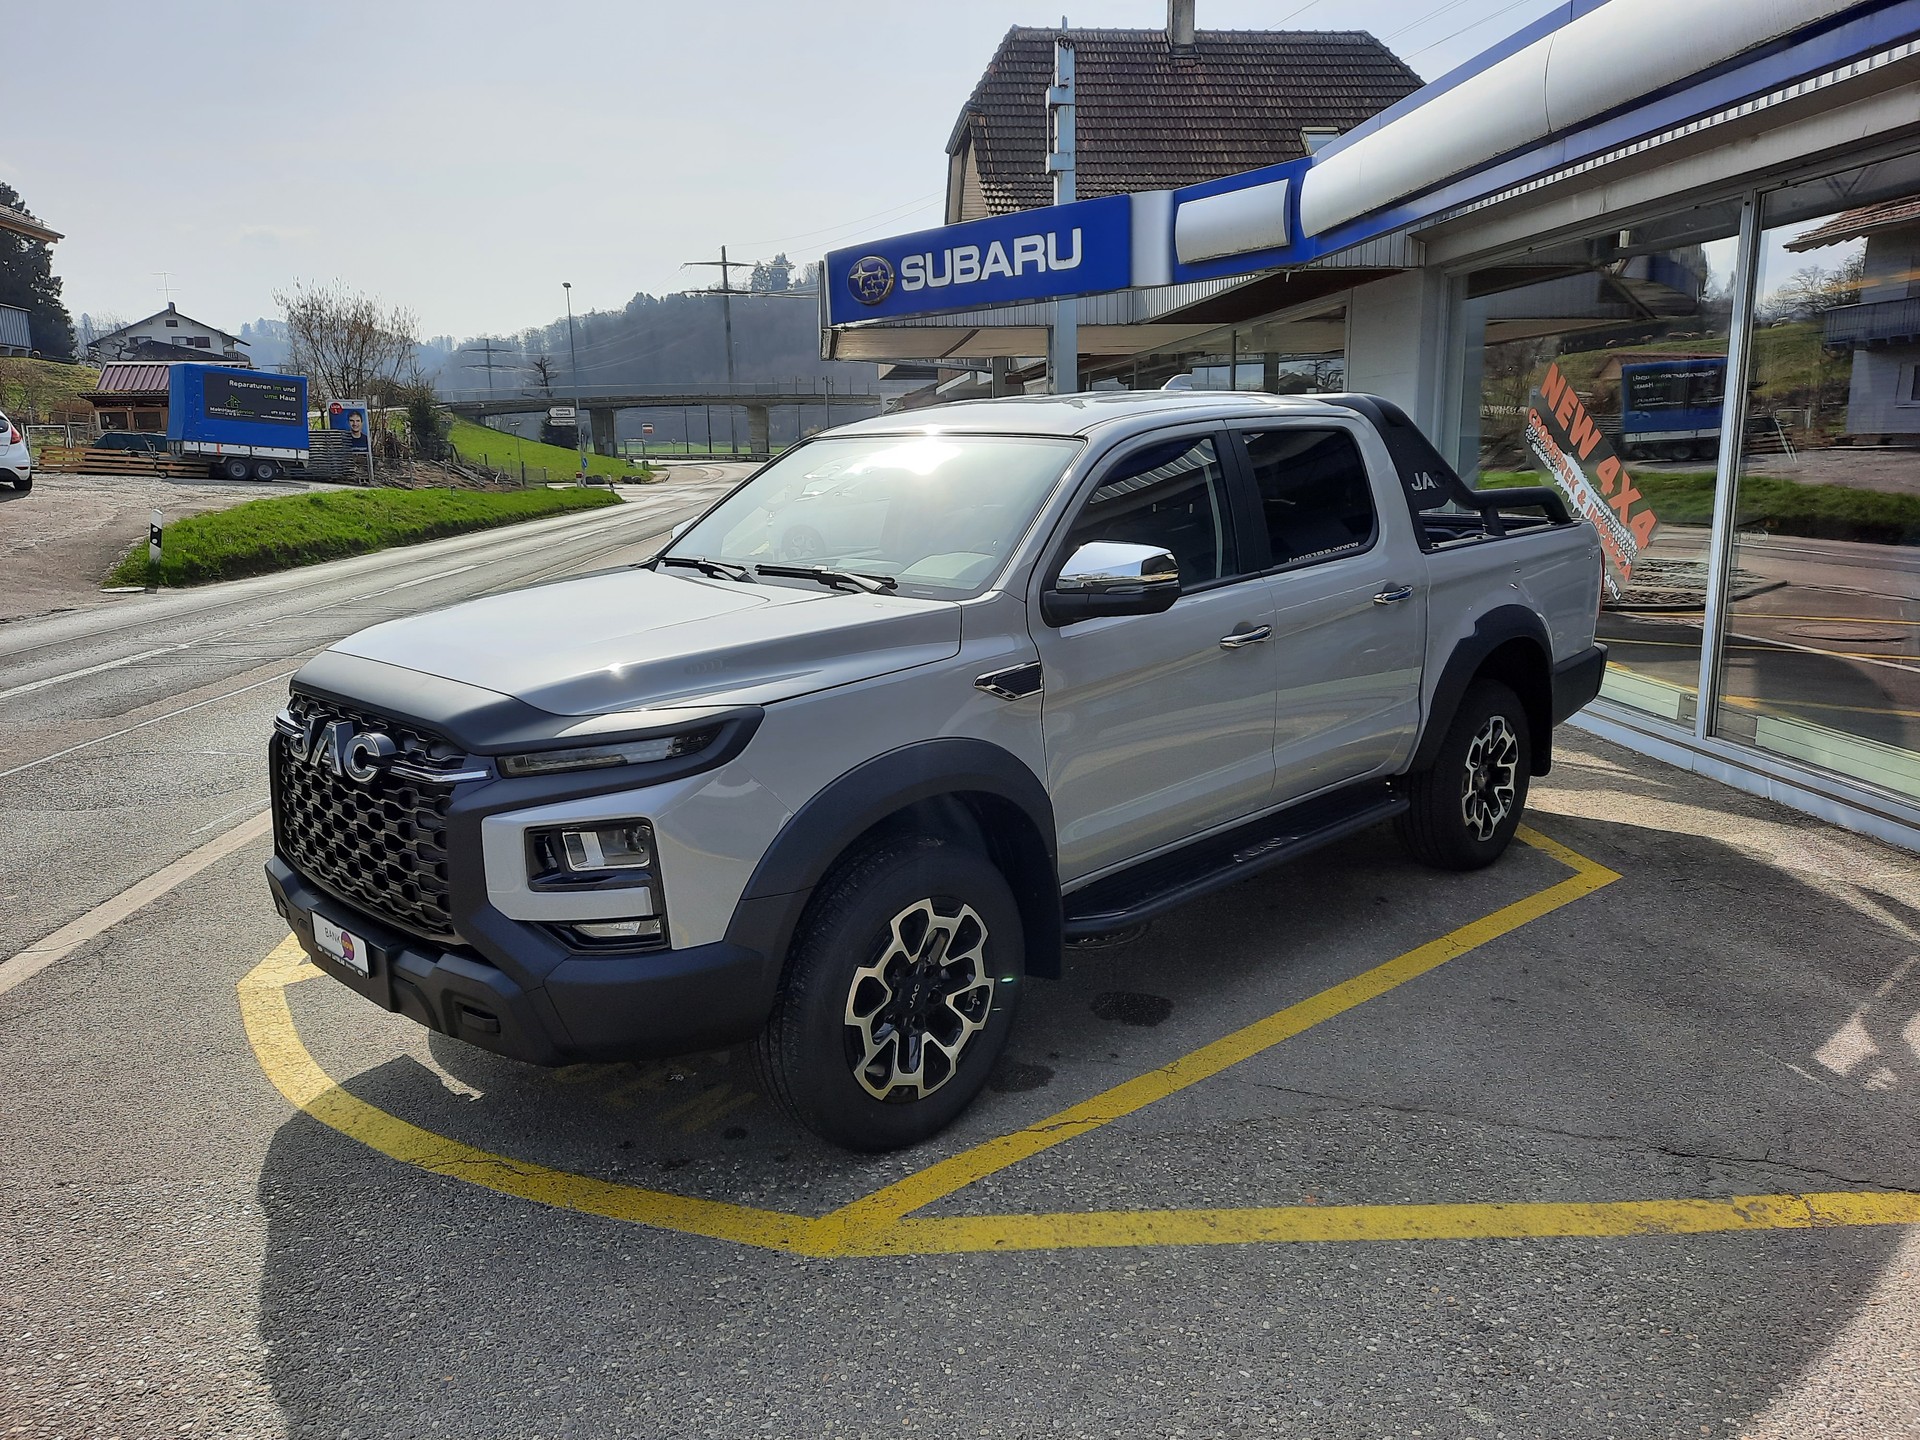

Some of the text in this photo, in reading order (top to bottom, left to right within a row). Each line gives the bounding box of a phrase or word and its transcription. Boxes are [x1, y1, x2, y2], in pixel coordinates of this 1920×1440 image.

[900, 227, 1082, 291] SUBARU
[229, 379, 271, 390] Reparaturen
[279, 394, 296, 402] Haus
[1539, 362, 1603, 461] NEW
[1411, 471, 1440, 491] JA
[1528, 408, 1580, 495] CROSSTREK
[1595, 455, 1658, 550] 4X4
[290, 714, 398, 783] JAC
[909, 983, 920, 1009] JAC
